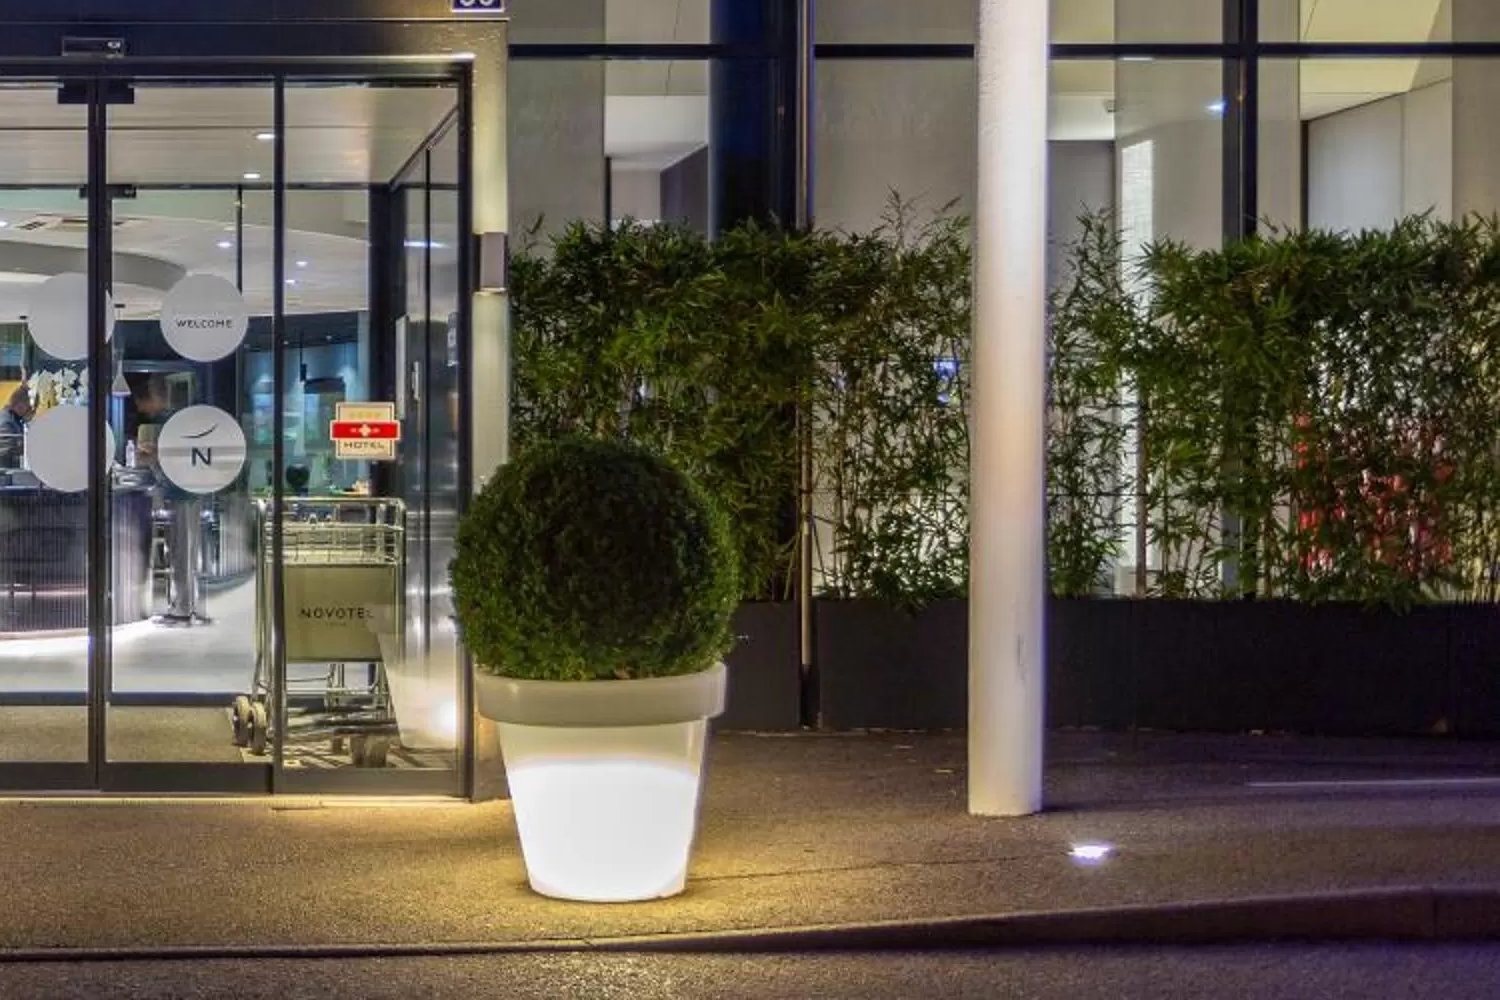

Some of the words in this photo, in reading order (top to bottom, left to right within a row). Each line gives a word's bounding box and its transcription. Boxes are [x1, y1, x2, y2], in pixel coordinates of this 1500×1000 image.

[176, 319, 233, 329] WELCOME
[343, 441, 385, 449] HOTEL
[191, 447, 212, 467] N
[301, 607, 375, 619] NOVOTEL
